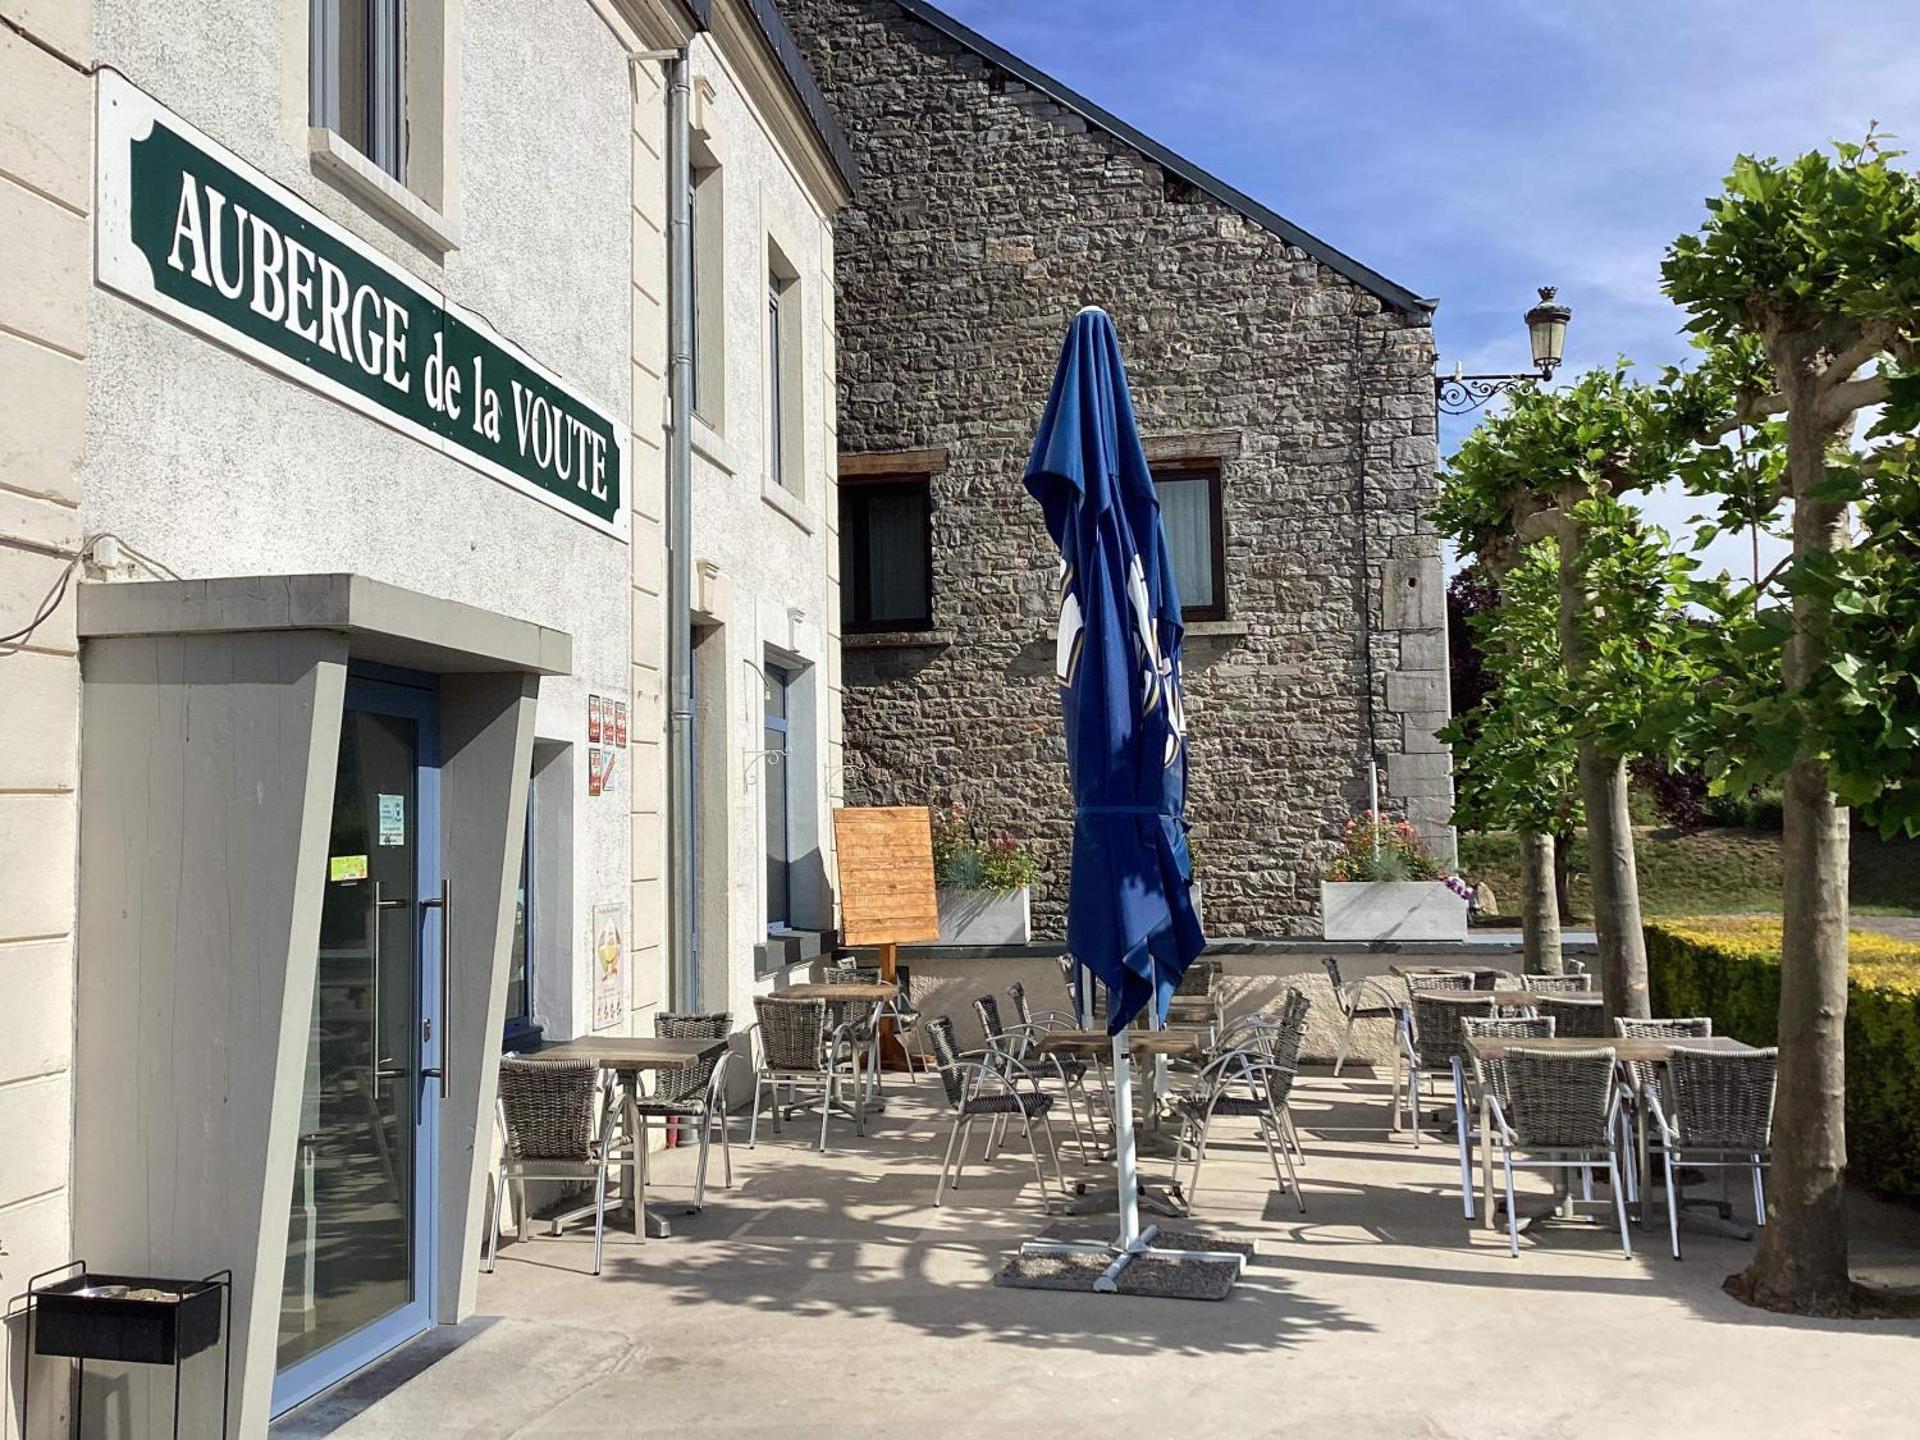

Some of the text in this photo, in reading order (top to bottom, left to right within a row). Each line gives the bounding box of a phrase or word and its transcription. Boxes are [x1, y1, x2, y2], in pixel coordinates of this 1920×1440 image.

[167, 170, 609, 502] AUBERGE de la VOUTE
